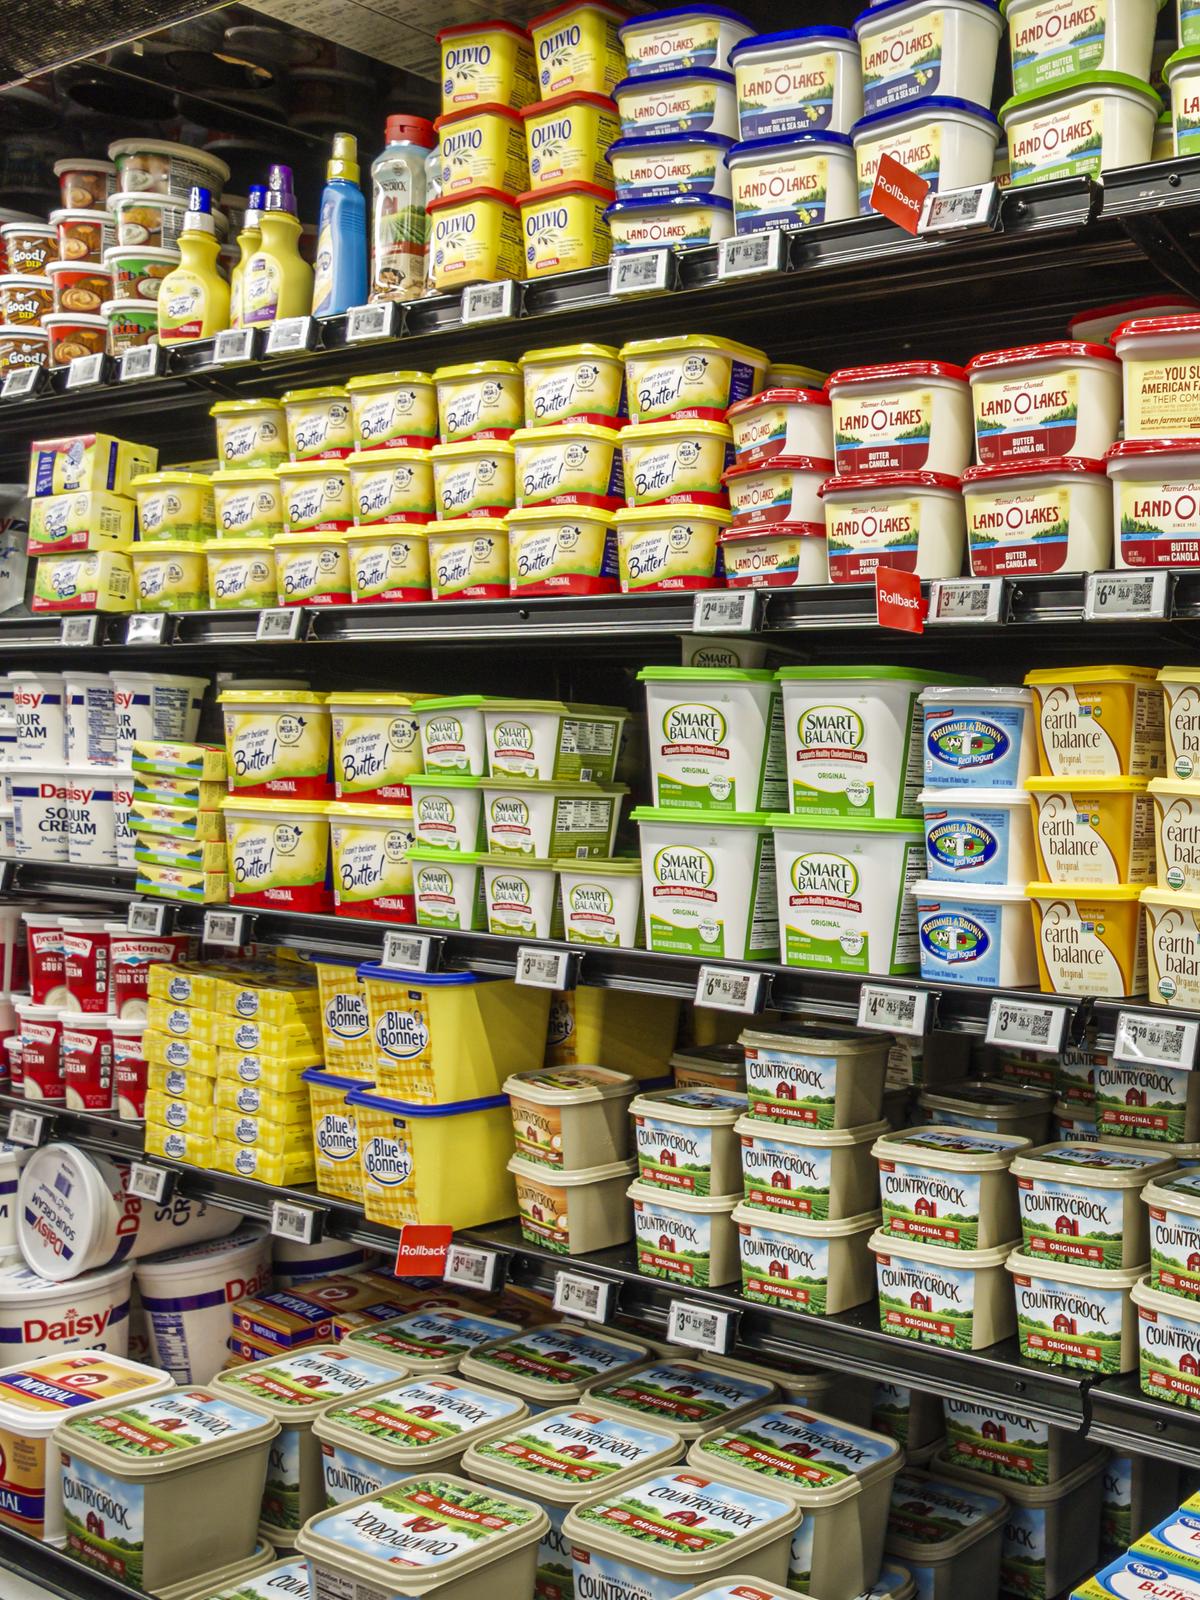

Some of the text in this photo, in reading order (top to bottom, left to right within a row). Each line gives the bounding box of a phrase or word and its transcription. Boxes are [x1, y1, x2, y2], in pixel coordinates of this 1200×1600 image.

[539, 25, 581, 61] OLIVIO
[445, 45, 491, 68] OLIVIO
[743, 79, 772, 96] LAND
[792, 71, 827, 90] LAKES
[453, 93, 478, 102] ORIGINAL
[877, 174, 921, 213] Rollback
[435, 212, 476, 241] OLIVIO
[525, 207, 568, 237] OLIVIO
[13, 249, 45, 263] Good!
[1165, 367, 1186, 380] YOU
[640, 374, 680, 412] Butter!
[1142, 382, 1190, 394] AMERICAN
[1154, 395, 1177, 404] THEIR
[1159, 417, 1186, 425] farmers
[880, 589, 919, 610] Rollback
[807, 715, 854, 730] SMART
[1045, 710, 1077, 731] earth
[805, 731, 856, 745] BALANCE
[931, 723, 967, 742] BRUMMEL
[975, 722, 1003, 743] BROWN
[1052, 730, 1100, 749] balance
[343, 743, 389, 781] Butter!
[939, 752, 949, 760] Made
[958, 756, 972, 765] Real
[972, 752, 994, 765] Yogurt
[1059, 753, 1082, 765] Original
[818, 772, 847, 780] ORIGINAL
[387, 1012, 414, 1033] Blue
[379, 1028, 425, 1048] Bonnet
[401, 1244, 446, 1258] Rollback
[23, 1310, 109, 1344] Daisy
[1047, 1339, 1083, 1354] ORIGINAL
[13, 1377, 73, 1402] IMPERIAL
